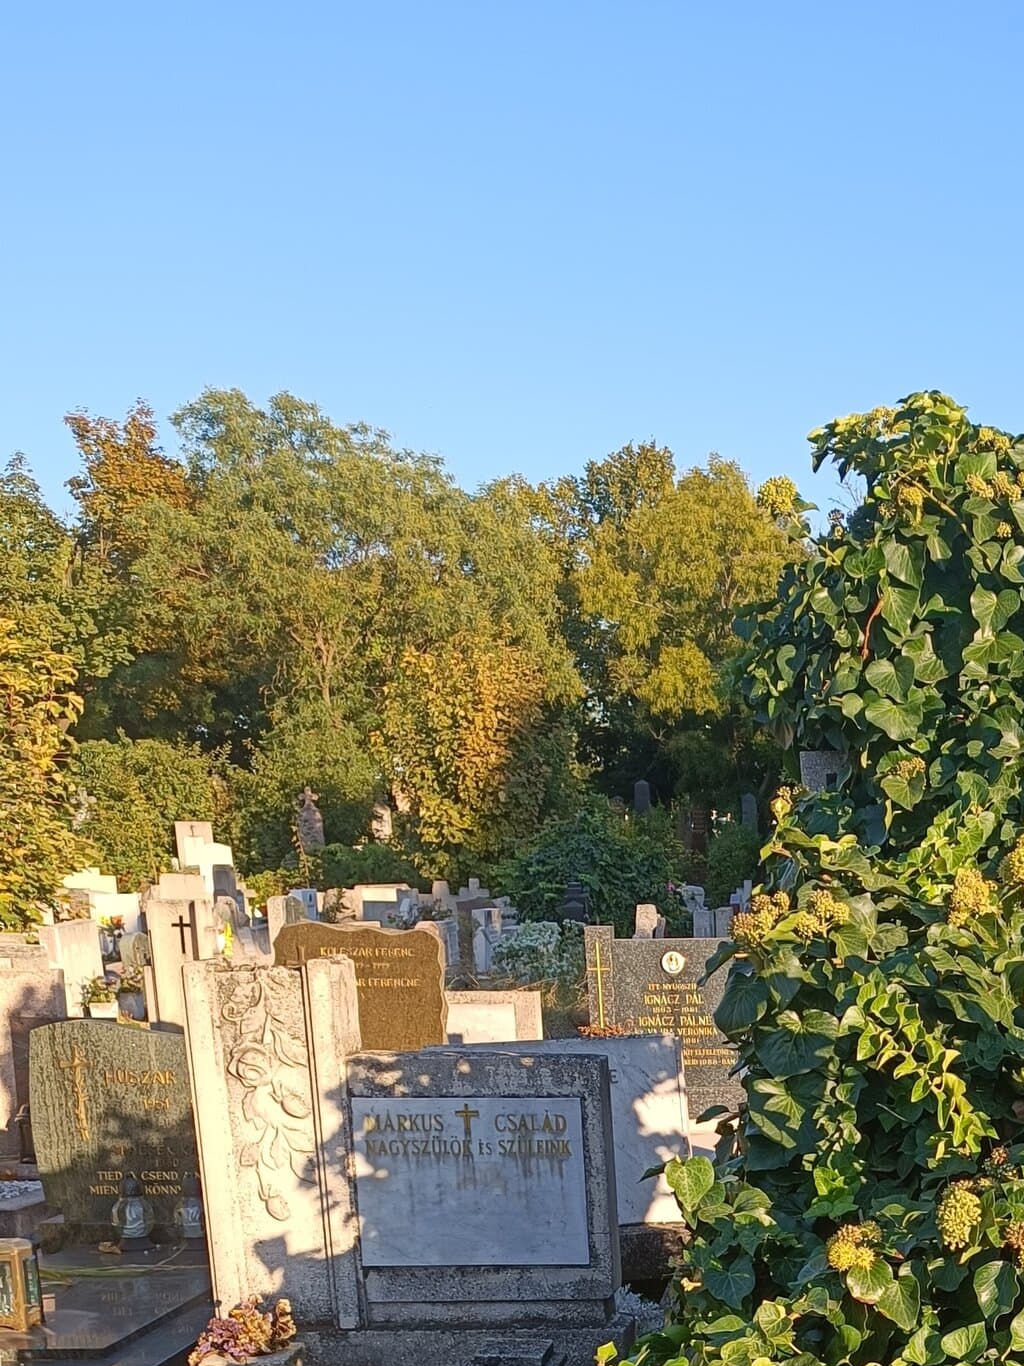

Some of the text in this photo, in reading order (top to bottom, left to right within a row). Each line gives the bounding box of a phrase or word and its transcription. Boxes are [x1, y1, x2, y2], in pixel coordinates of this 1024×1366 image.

[644, 992, 704, 1005] IGNÁCZ PÁL
[638, 1014, 675, 1026] IGNÁCZ
[364, 1109, 568, 1134] MÁRKUS CSALÁD
[140, 1170, 179, 1181] CSEND
